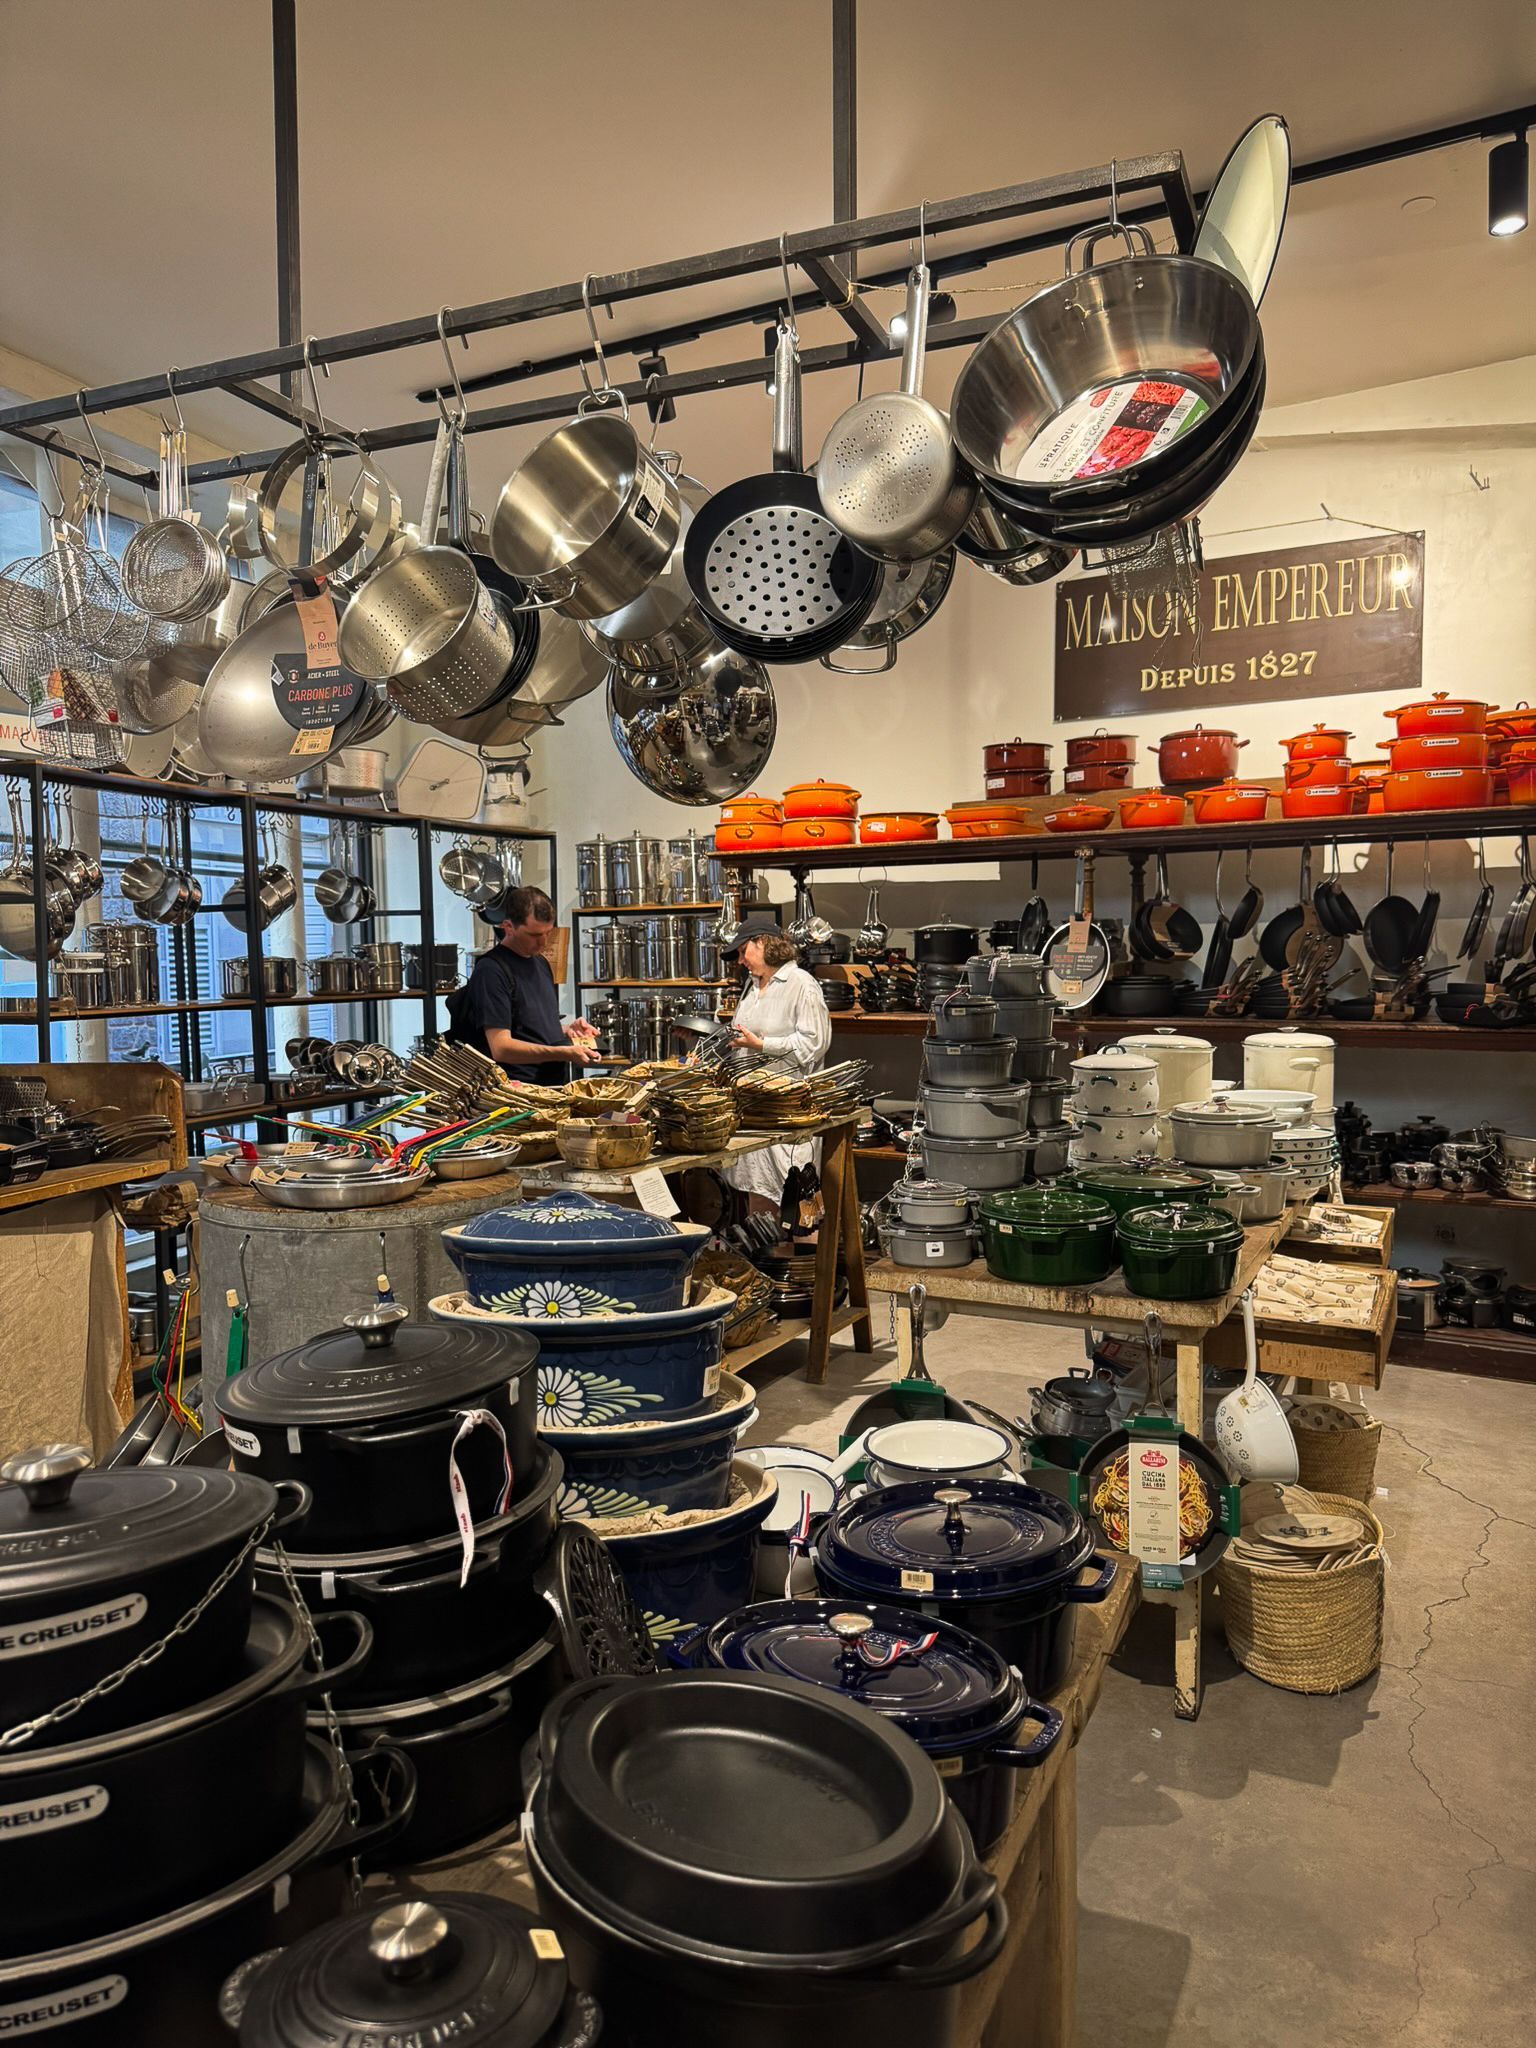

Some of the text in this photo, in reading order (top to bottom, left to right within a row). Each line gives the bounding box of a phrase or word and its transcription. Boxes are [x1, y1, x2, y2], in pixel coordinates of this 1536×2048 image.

[1088, 391, 1124, 433] CONFITURE
[1043, 422, 1079, 463] PRATIQUE
[1064, 553, 1414, 650] MAISON EMPEREUR
[308, 641, 337, 651] de Buyer
[1247, 650, 1318, 681] 1827
[288, 683, 353, 702] CARBONE PLUS
[0, 1603, 136, 1650] E CREUSET
[0, 1794, 95, 1829] REUSET
[0, 1985, 114, 2030] CREUSET
